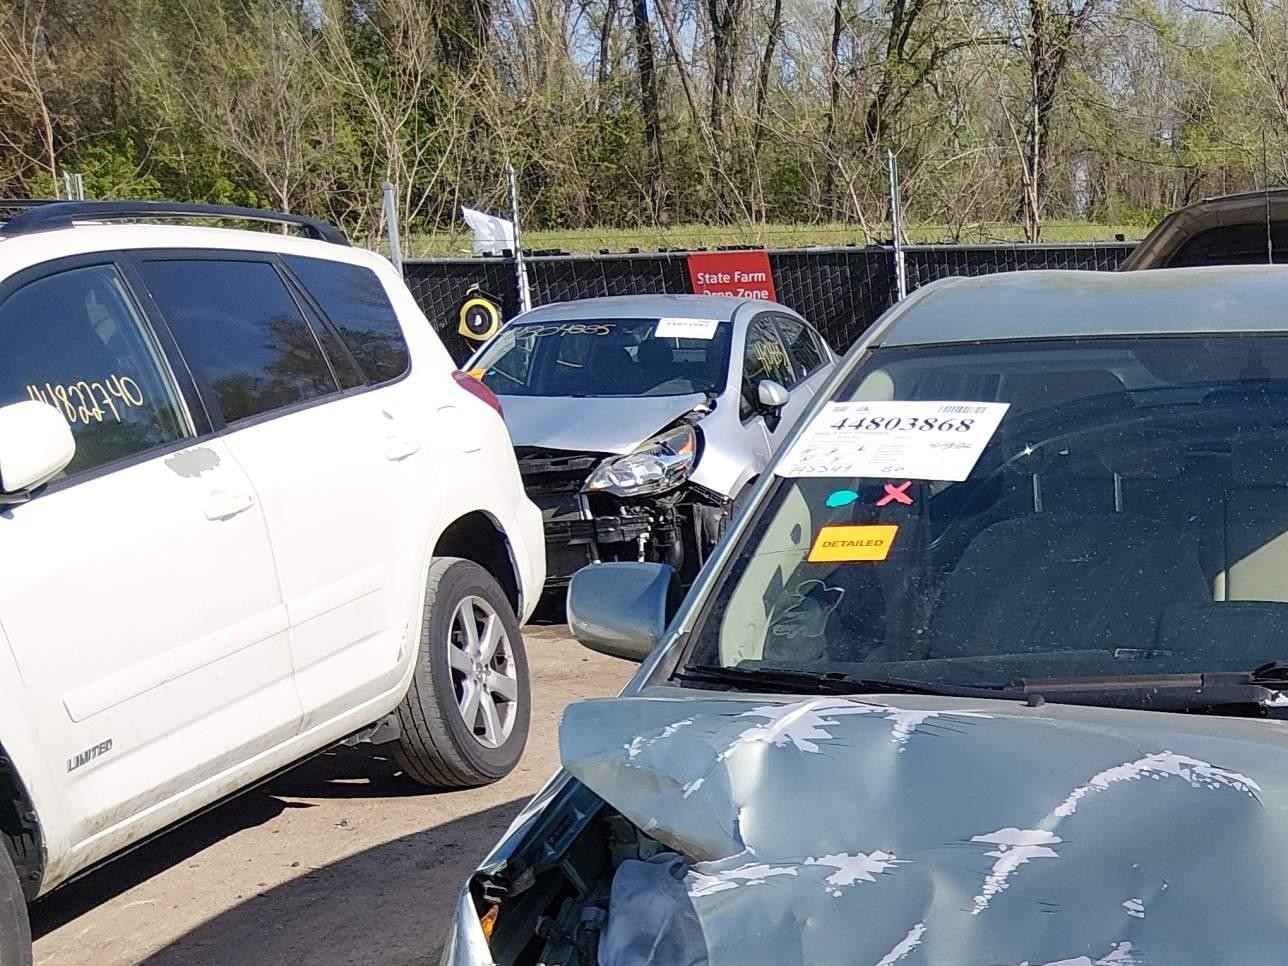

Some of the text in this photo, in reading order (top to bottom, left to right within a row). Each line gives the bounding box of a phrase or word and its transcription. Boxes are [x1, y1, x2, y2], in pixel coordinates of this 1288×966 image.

[697, 271, 766, 285] State Farm
[736, 288, 769, 299] Zone
[830, 416, 975, 433] 44803868
[821, 539, 884, 548] DETAILED
[66, 738, 112, 773] LIMITED
